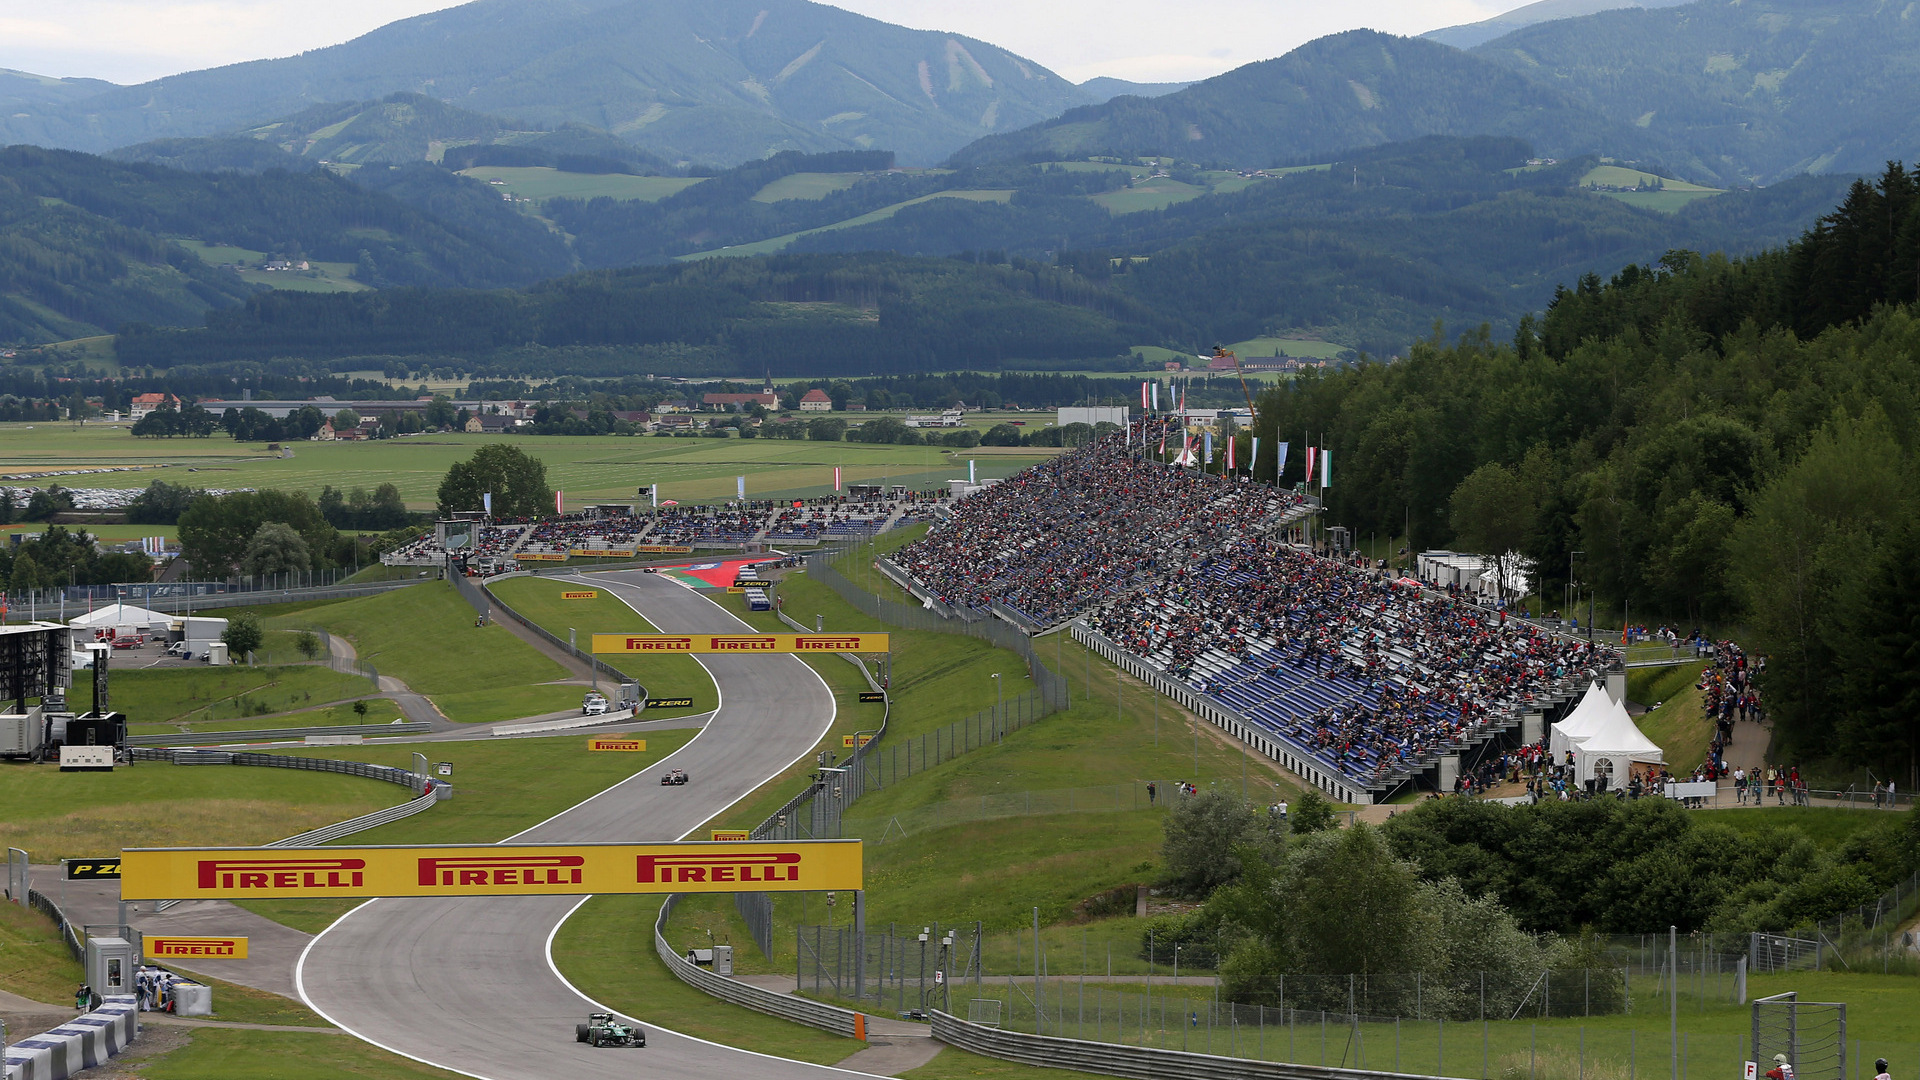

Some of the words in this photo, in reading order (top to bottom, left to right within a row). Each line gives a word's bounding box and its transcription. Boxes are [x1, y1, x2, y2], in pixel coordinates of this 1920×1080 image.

[626, 638, 691, 650] PIRELLI
[711, 637, 776, 650] PIRELLI
[795, 637, 861, 649] PIRELLI
[595, 741, 639, 750] PIRELLI
[73, 865, 92, 875] P
[198, 859, 366, 889] PIRELLI
[418, 856, 585, 886] PIRELLI
[636, 853, 802, 883] PIRELLI
[154, 939, 235, 955] PIRELLI
[1747, 1065, 1754, 1076] F
